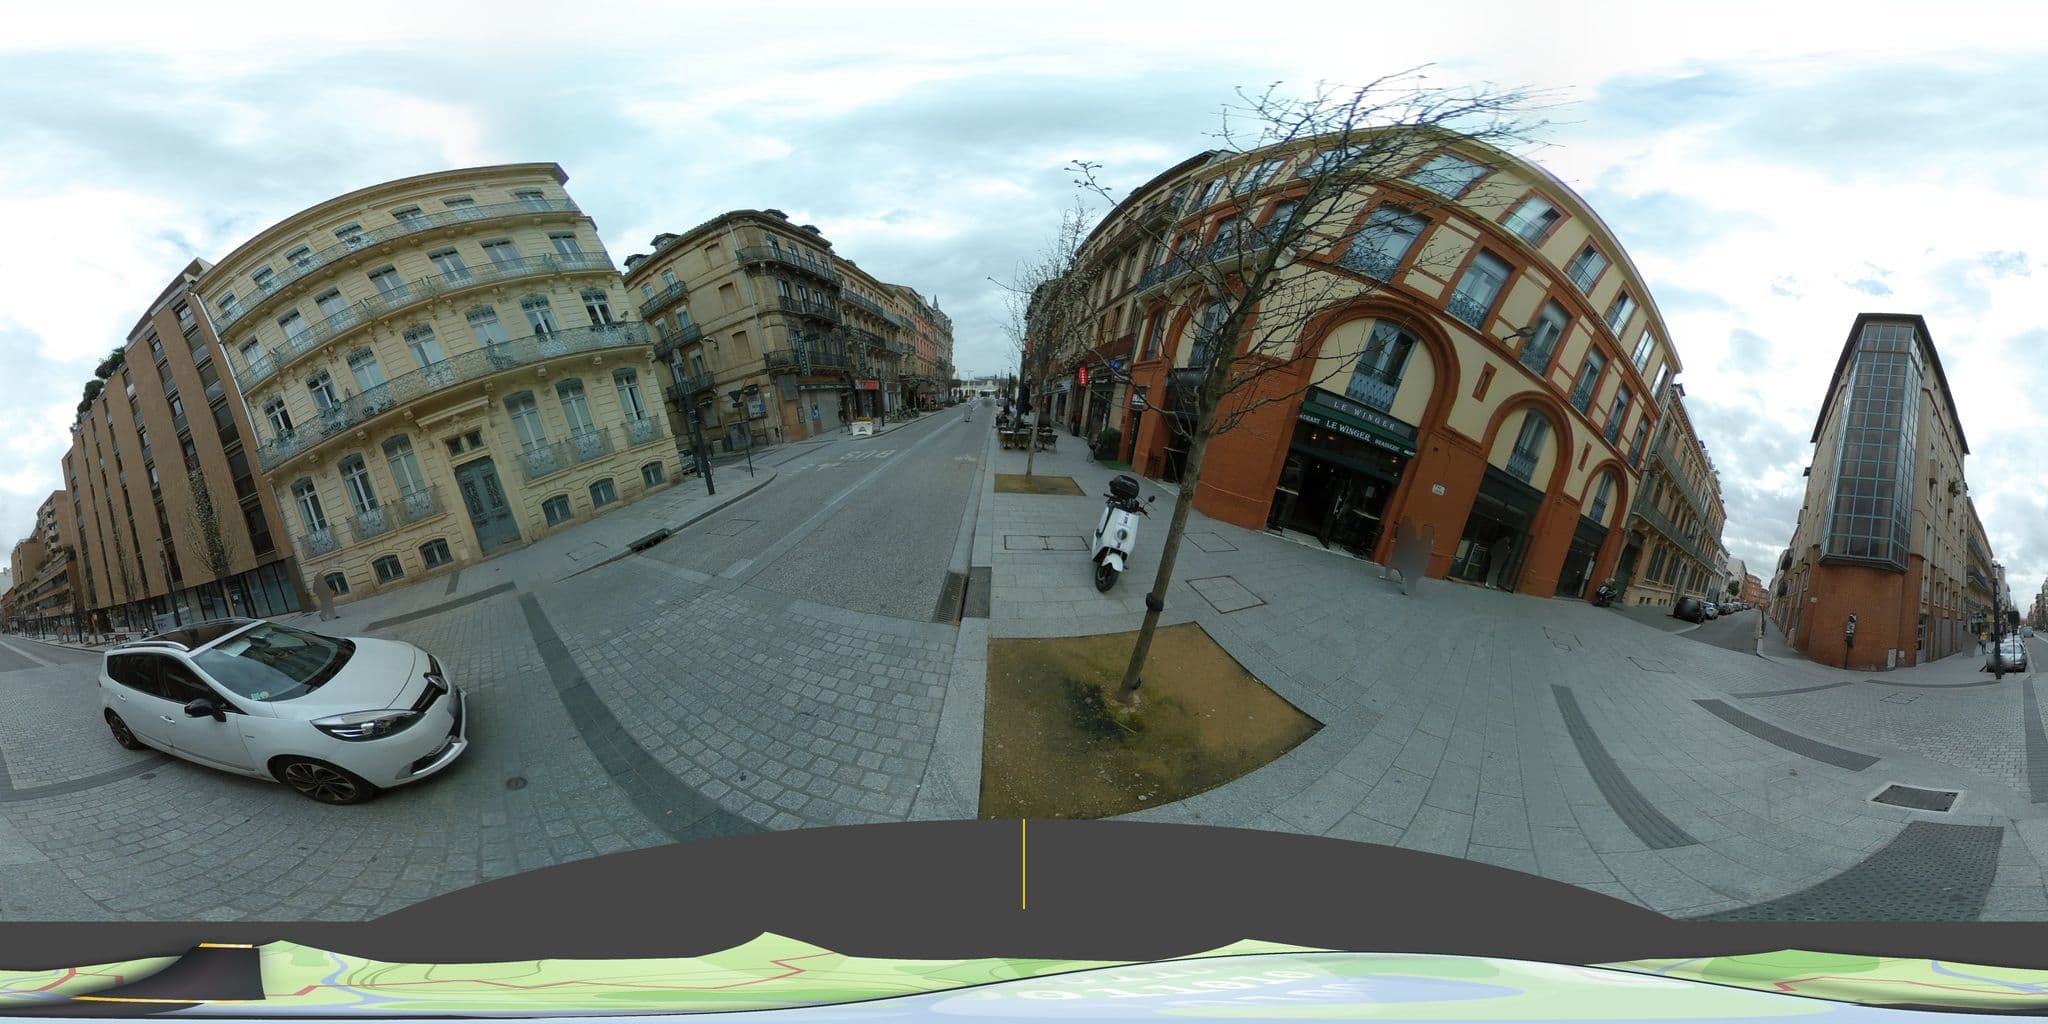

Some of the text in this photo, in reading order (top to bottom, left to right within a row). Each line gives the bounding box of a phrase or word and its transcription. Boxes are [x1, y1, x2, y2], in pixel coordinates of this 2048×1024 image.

[1334, 401, 1395, 431] LE WINGER
[1326, 420, 1337, 430] LE
[1339, 423, 1371, 442] WINGER
